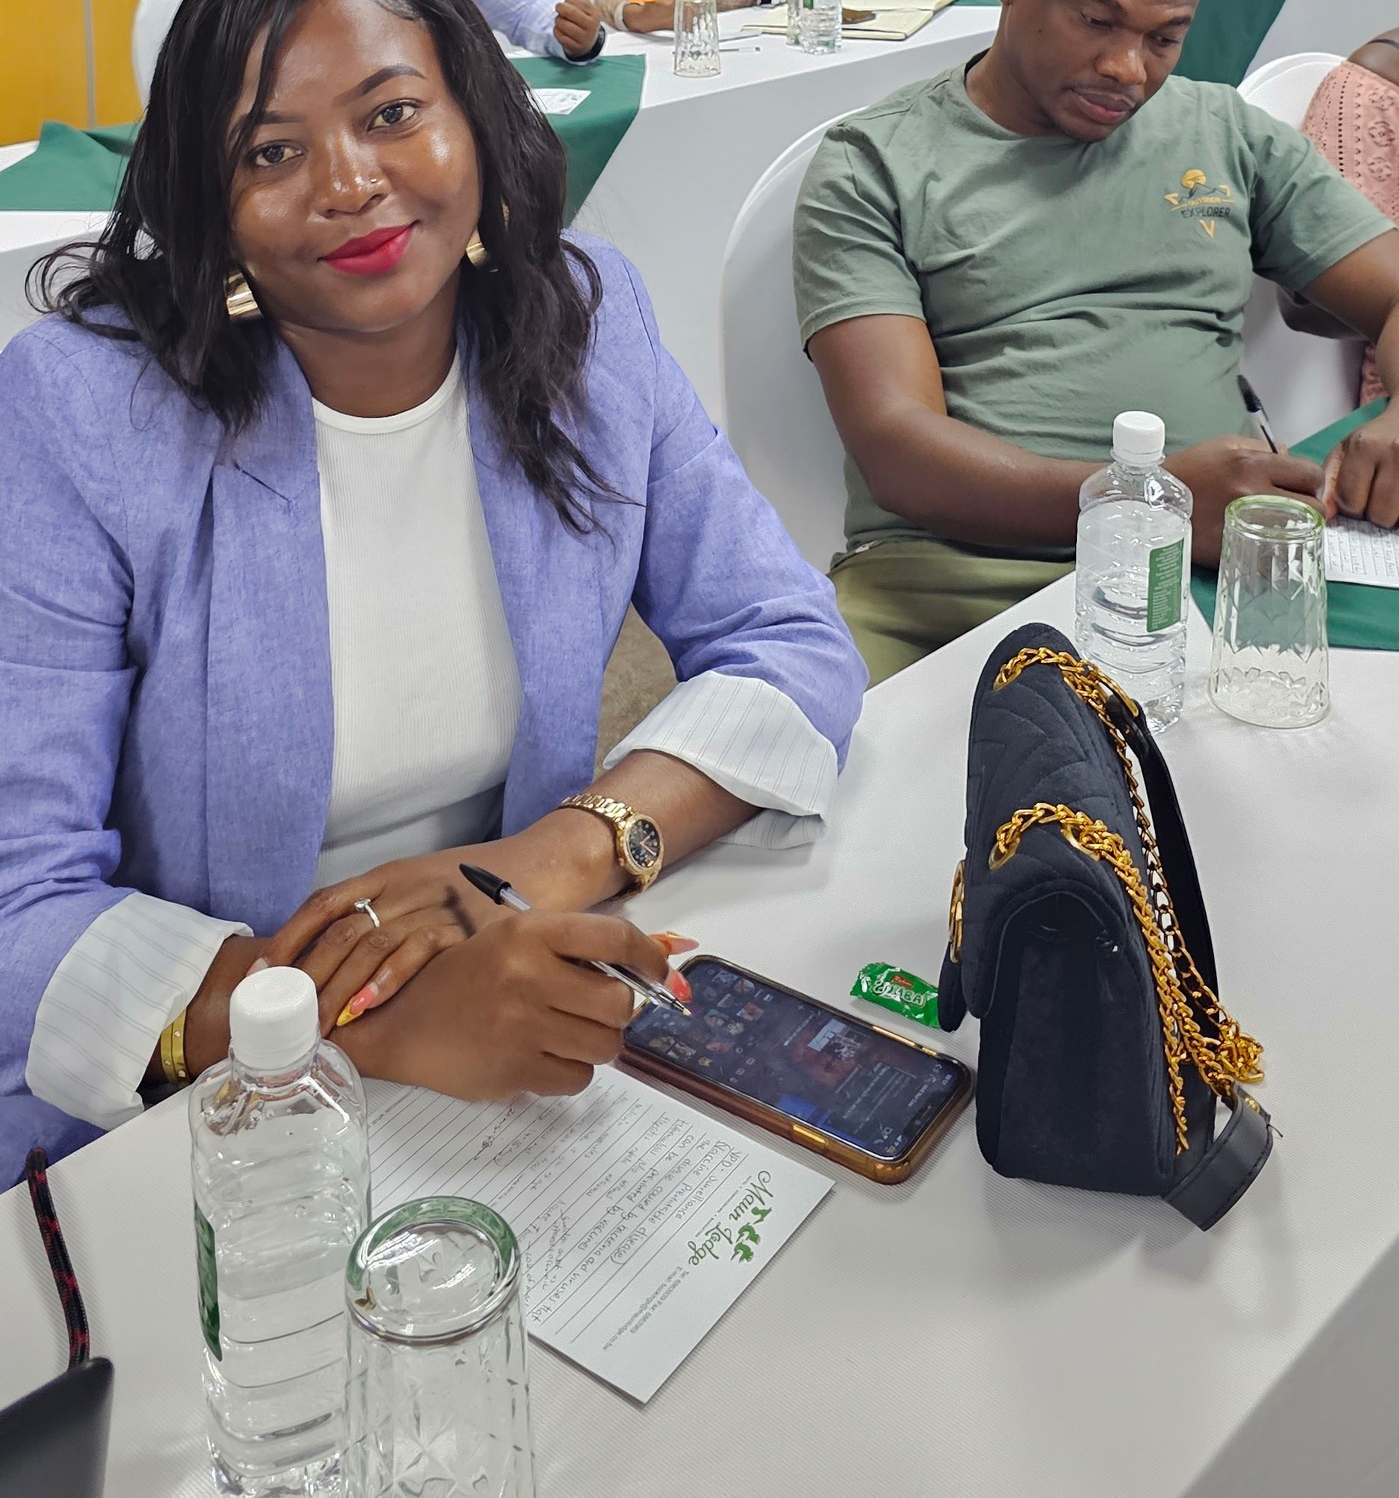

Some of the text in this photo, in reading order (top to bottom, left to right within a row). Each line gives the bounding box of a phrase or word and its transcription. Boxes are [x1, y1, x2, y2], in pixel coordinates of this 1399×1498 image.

[1180, 206, 1231, 219] EXPLORER
[729, 1171, 774, 1220] Maun
[687, 1222, 733, 1265] Lodge
